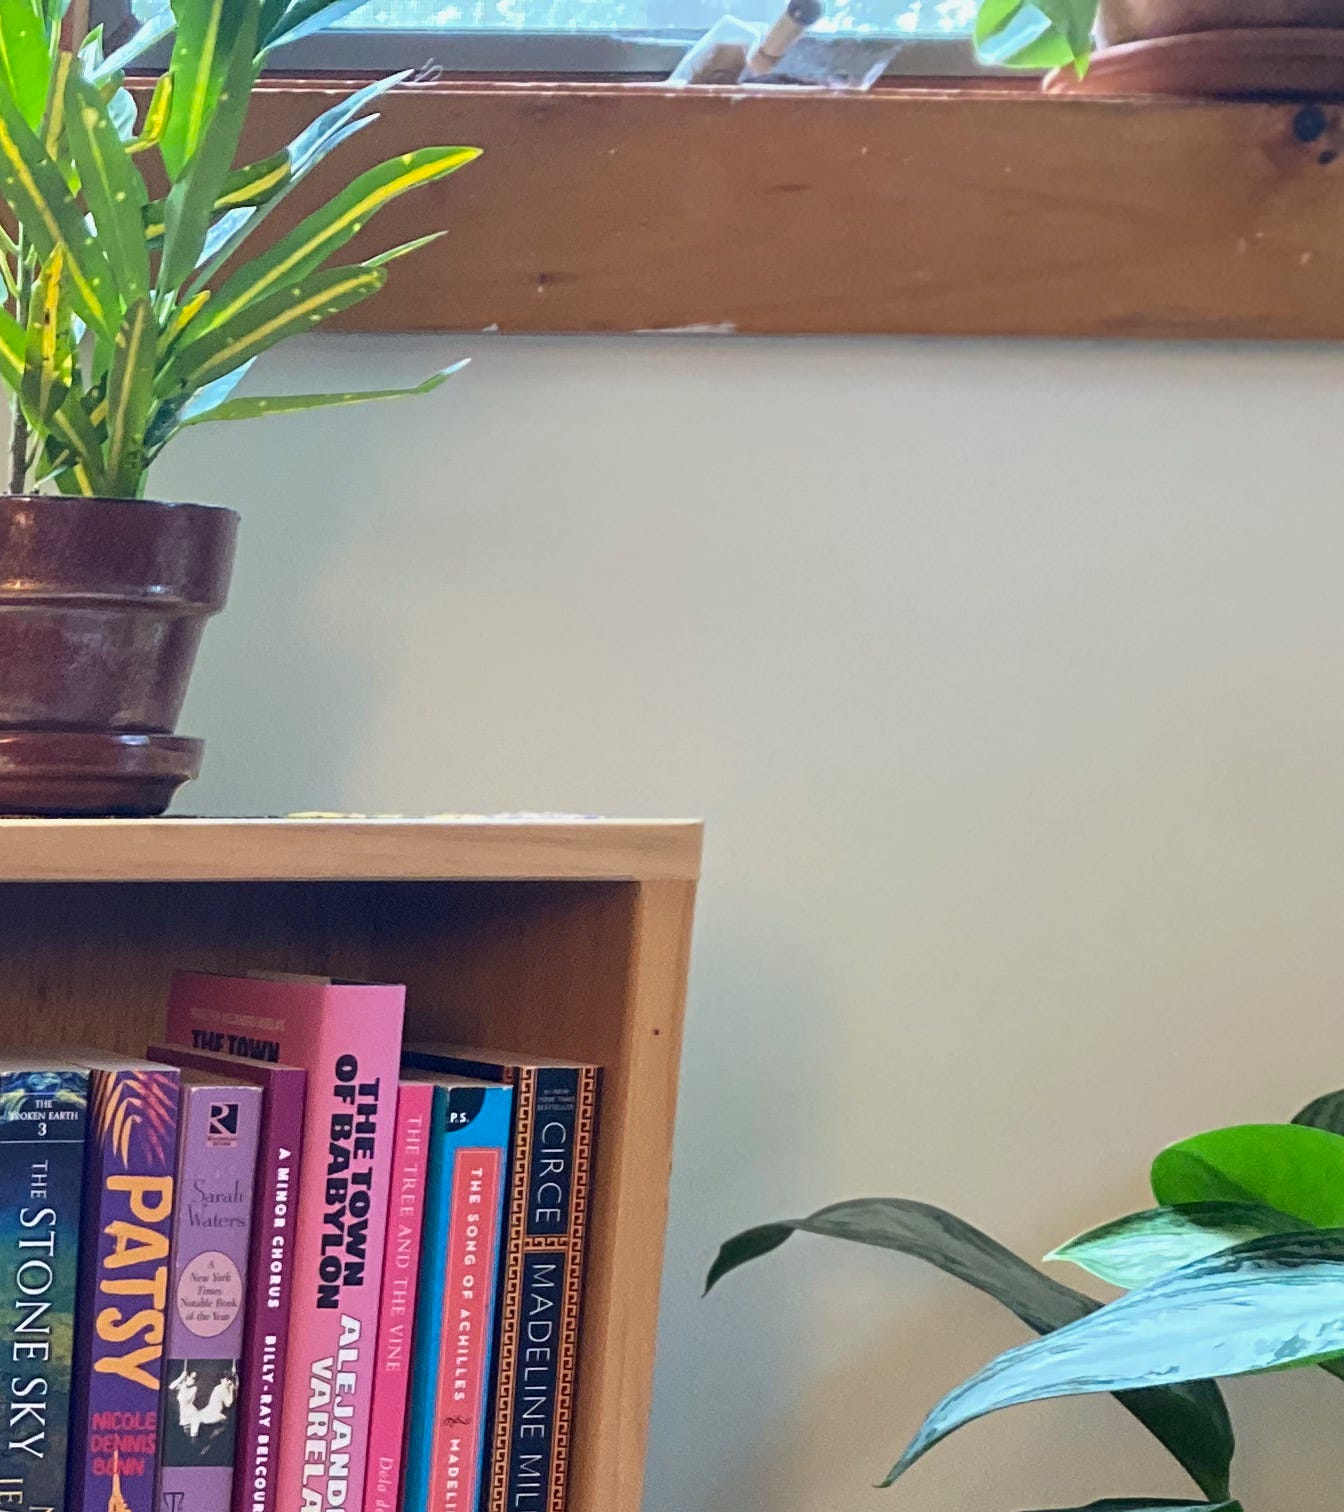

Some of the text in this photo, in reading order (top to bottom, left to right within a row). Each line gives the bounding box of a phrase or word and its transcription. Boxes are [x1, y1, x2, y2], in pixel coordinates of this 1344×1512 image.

[316, 1055, 358, 1309] OF BABYLON
[342, 1078, 380, 1287] THE TOWN
[450, 1111, 470, 1125] P.S.
[536, 1121, 568, 1227] CIRCE
[94, 1174, 174, 1391] PATSY
[267, 1167, 290, 1310] MINOR CHORUS
[7, 1207, 56, 1461] STONE SKY
[259, 1335, 276, 1429] BILLY-RAY
[454, 1306, 471, 1401] ACHILLES
[521, 1263, 556, 1442] MADELINE
